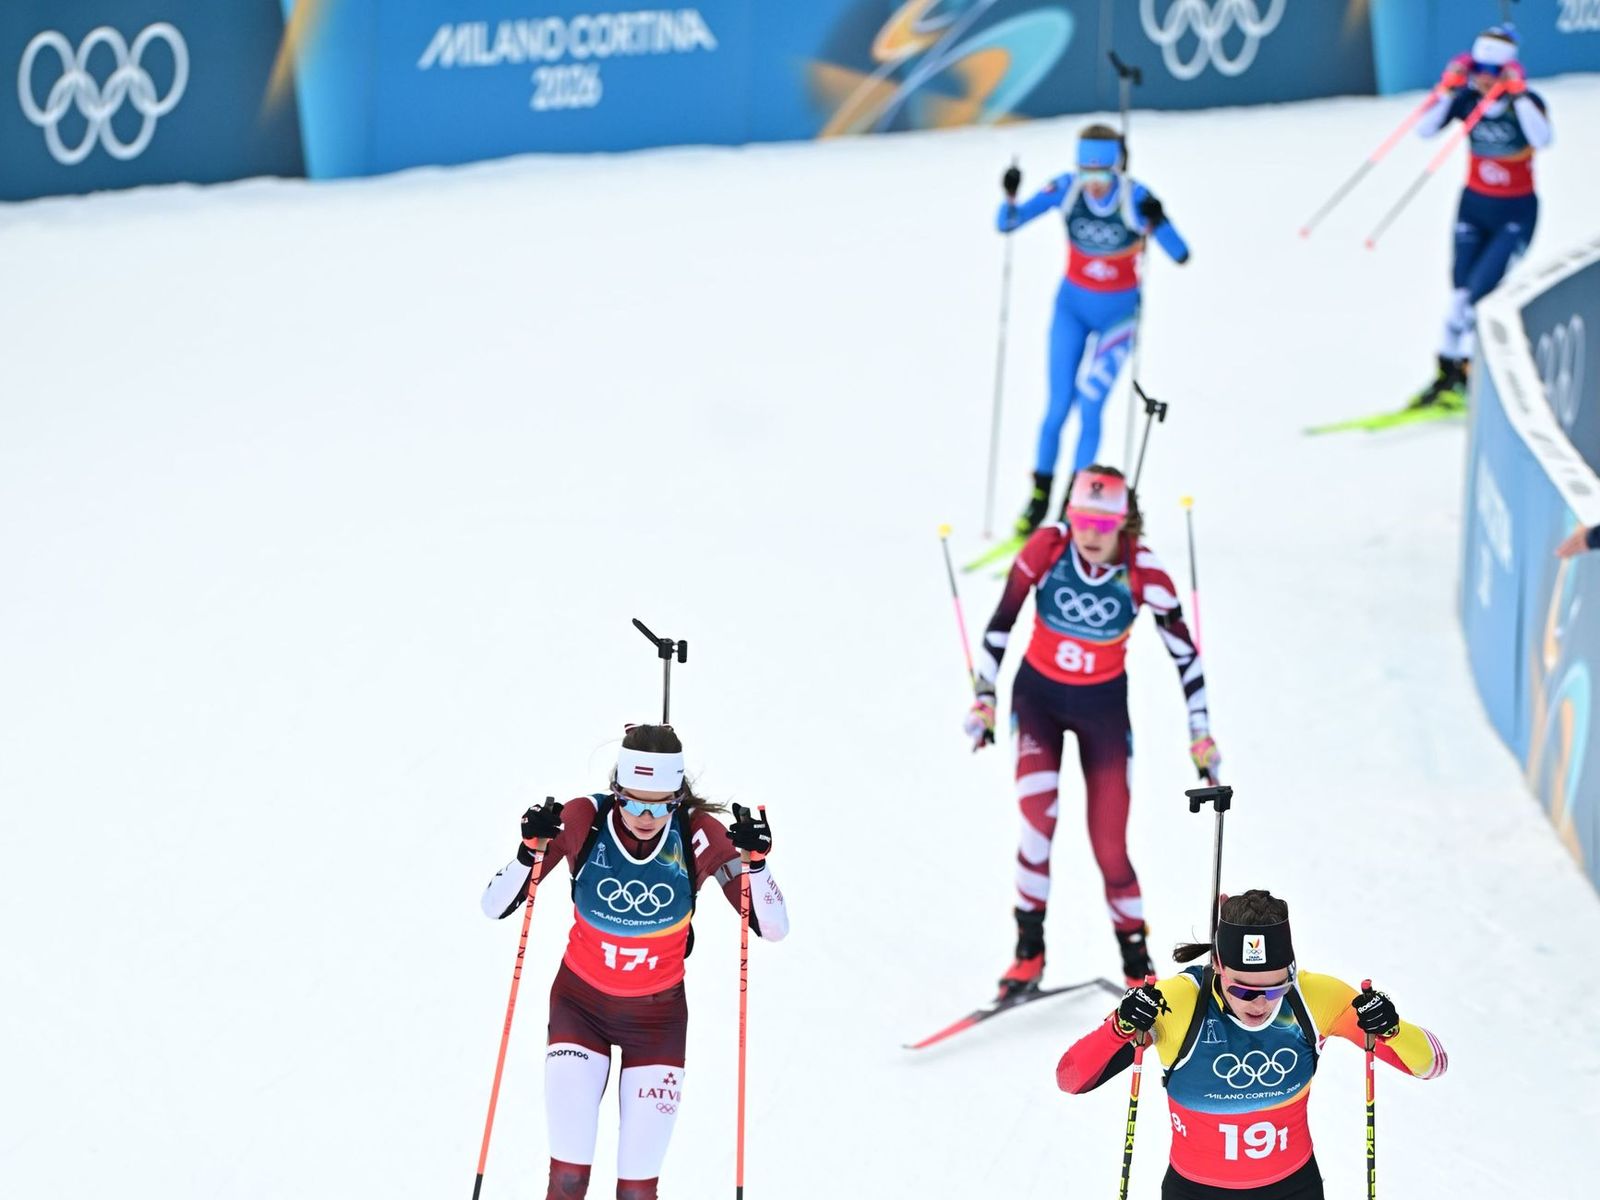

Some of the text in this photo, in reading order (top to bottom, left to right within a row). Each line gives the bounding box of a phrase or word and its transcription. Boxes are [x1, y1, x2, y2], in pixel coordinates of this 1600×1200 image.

[416, 9, 719, 70] MILANO CORTINA
[529, 62, 603, 111] 2026
[590, 909, 622, 925] MILANO
[622, 918, 657, 927] CORTINA
[638, 1087, 681, 1102] LATVI
[1245, 1091, 1285, 1099] CORTINA
[1125, 1107, 1137, 1153] LEKI
